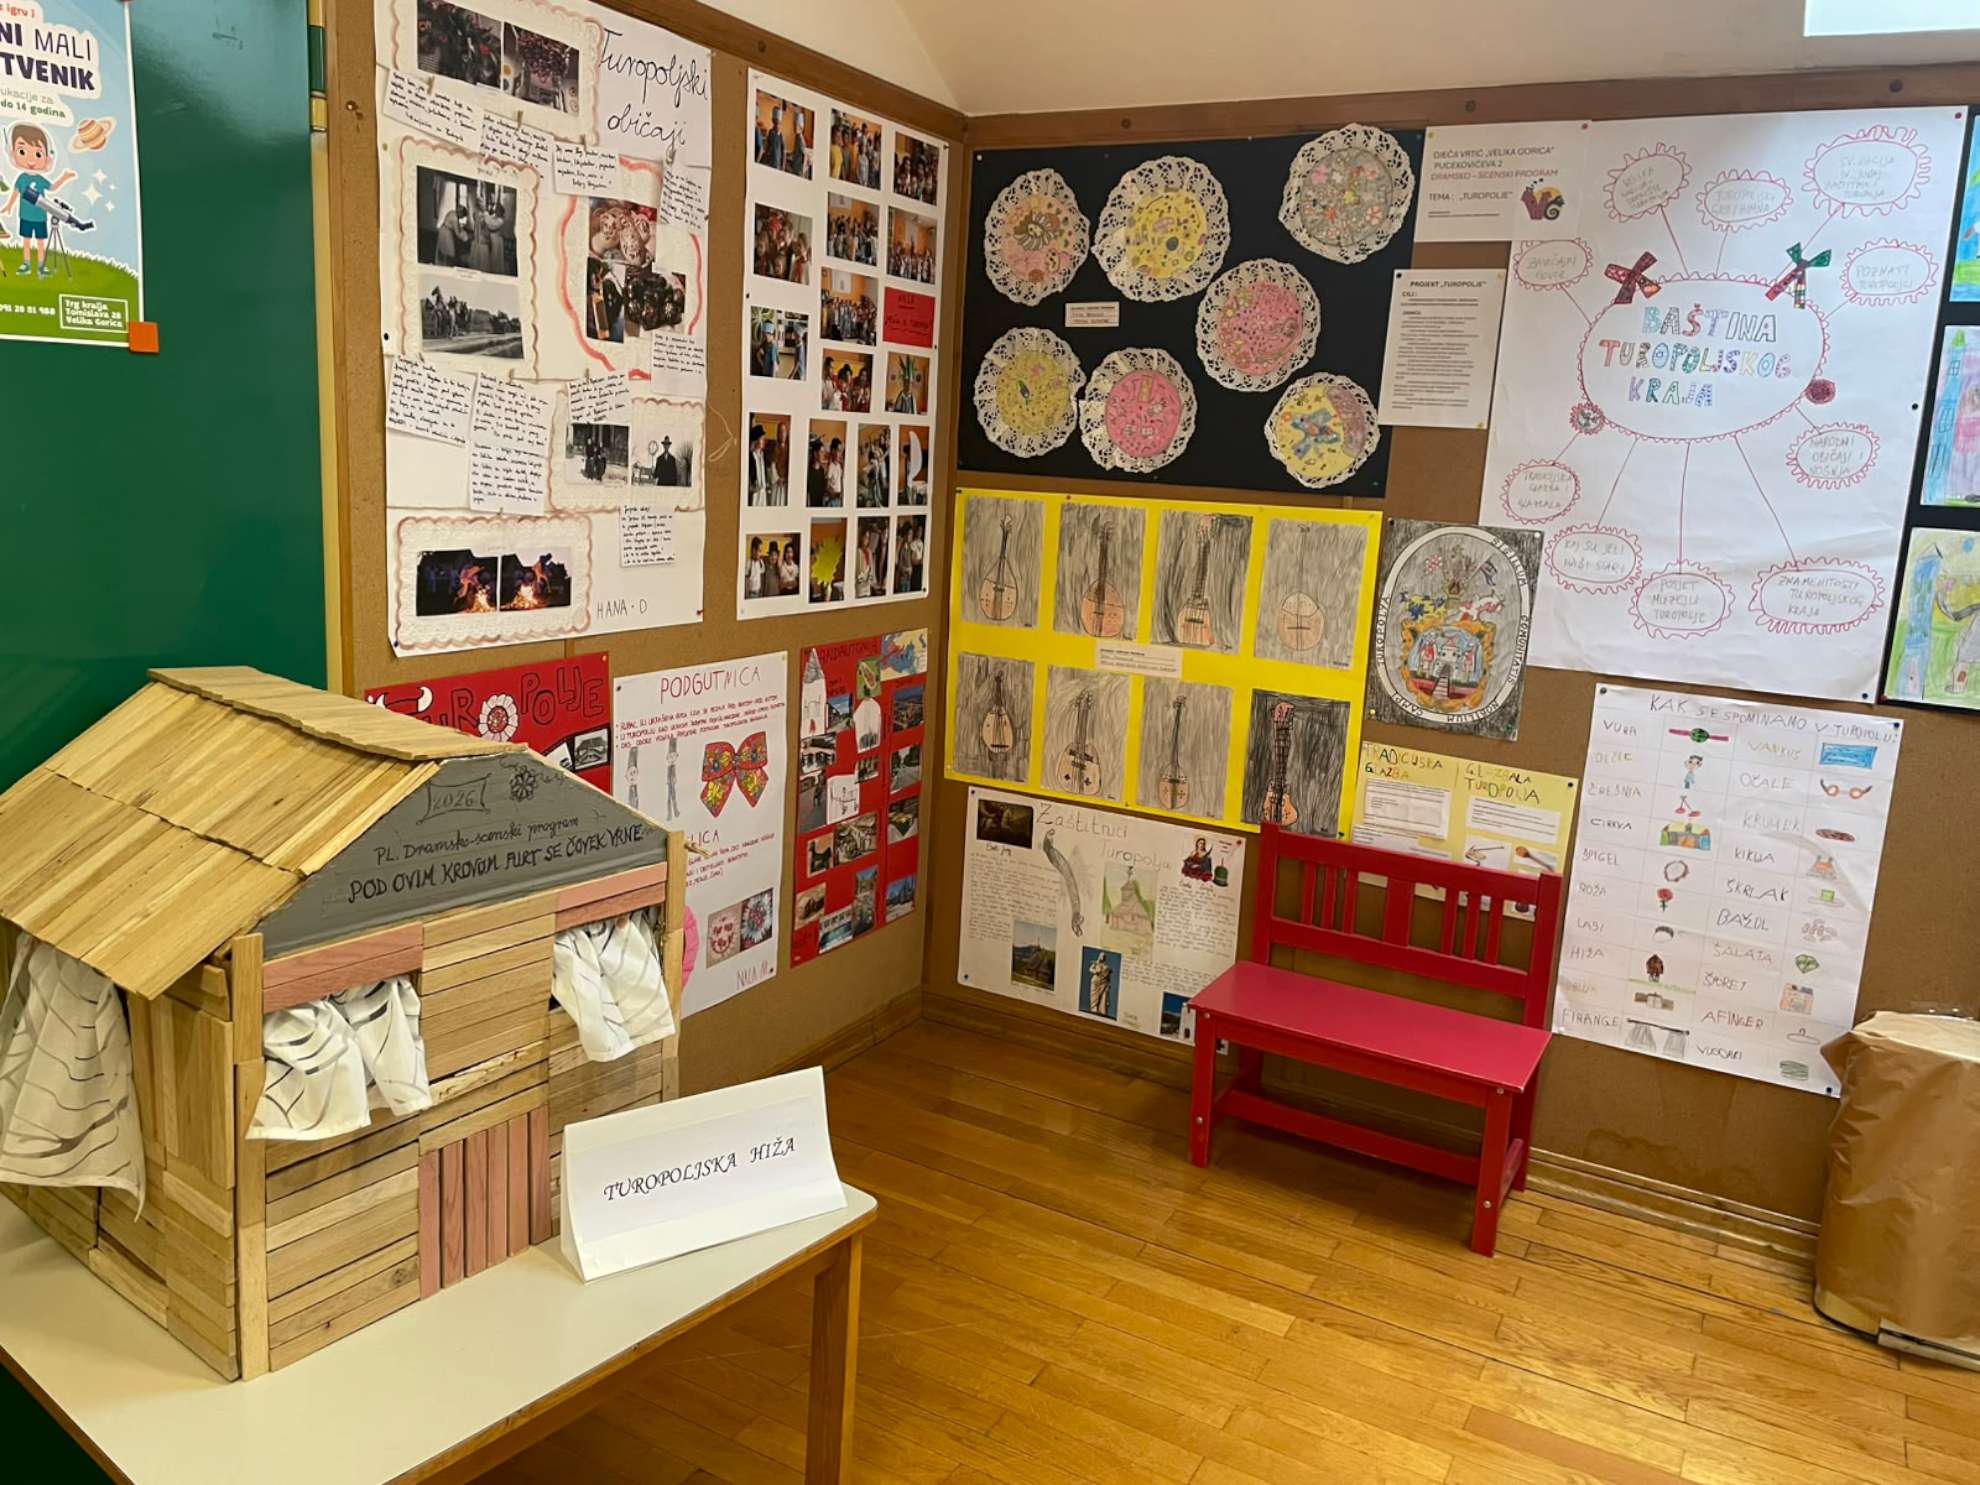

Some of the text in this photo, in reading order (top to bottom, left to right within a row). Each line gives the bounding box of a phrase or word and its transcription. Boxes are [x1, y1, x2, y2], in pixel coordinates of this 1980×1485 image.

[35, 28, 91, 61] MALI
[600, 27, 709, 108] Turopoljski
[30, 105, 66, 118] godina
[41, 94, 54, 104] za
[608, 105, 687, 150] običaji
[65, 300, 109, 311] Trg kralja
[66, 315, 123, 328] Velika Gorica
[1641, 302, 1777, 343] BAŠTINA
[1598, 338, 1793, 379] TUROPOLJSKOG
[1627, 375, 1714, 408] KRAJA
[597, 599, 628, 619] HANA
[660, 667, 761, 704] PODGUTNICA
[1650, 693, 1689, 713] KAK
[1696, 705, 1720, 719] SE
[1722, 711, 1808, 731] SPOMINAMO
[1814, 722, 1830, 733] V
[1739, 771, 1796, 790] OČALE
[432, 786, 477, 811] 2026
[527, 816, 580, 843] program
[348, 876, 387, 904] POD
[392, 867, 435, 892] OVIM
[504, 847, 542, 871] FURT
[543, 844, 562, 863] SE
[603, 1136, 796, 1202] TUROPOLJSKA HIŽA
